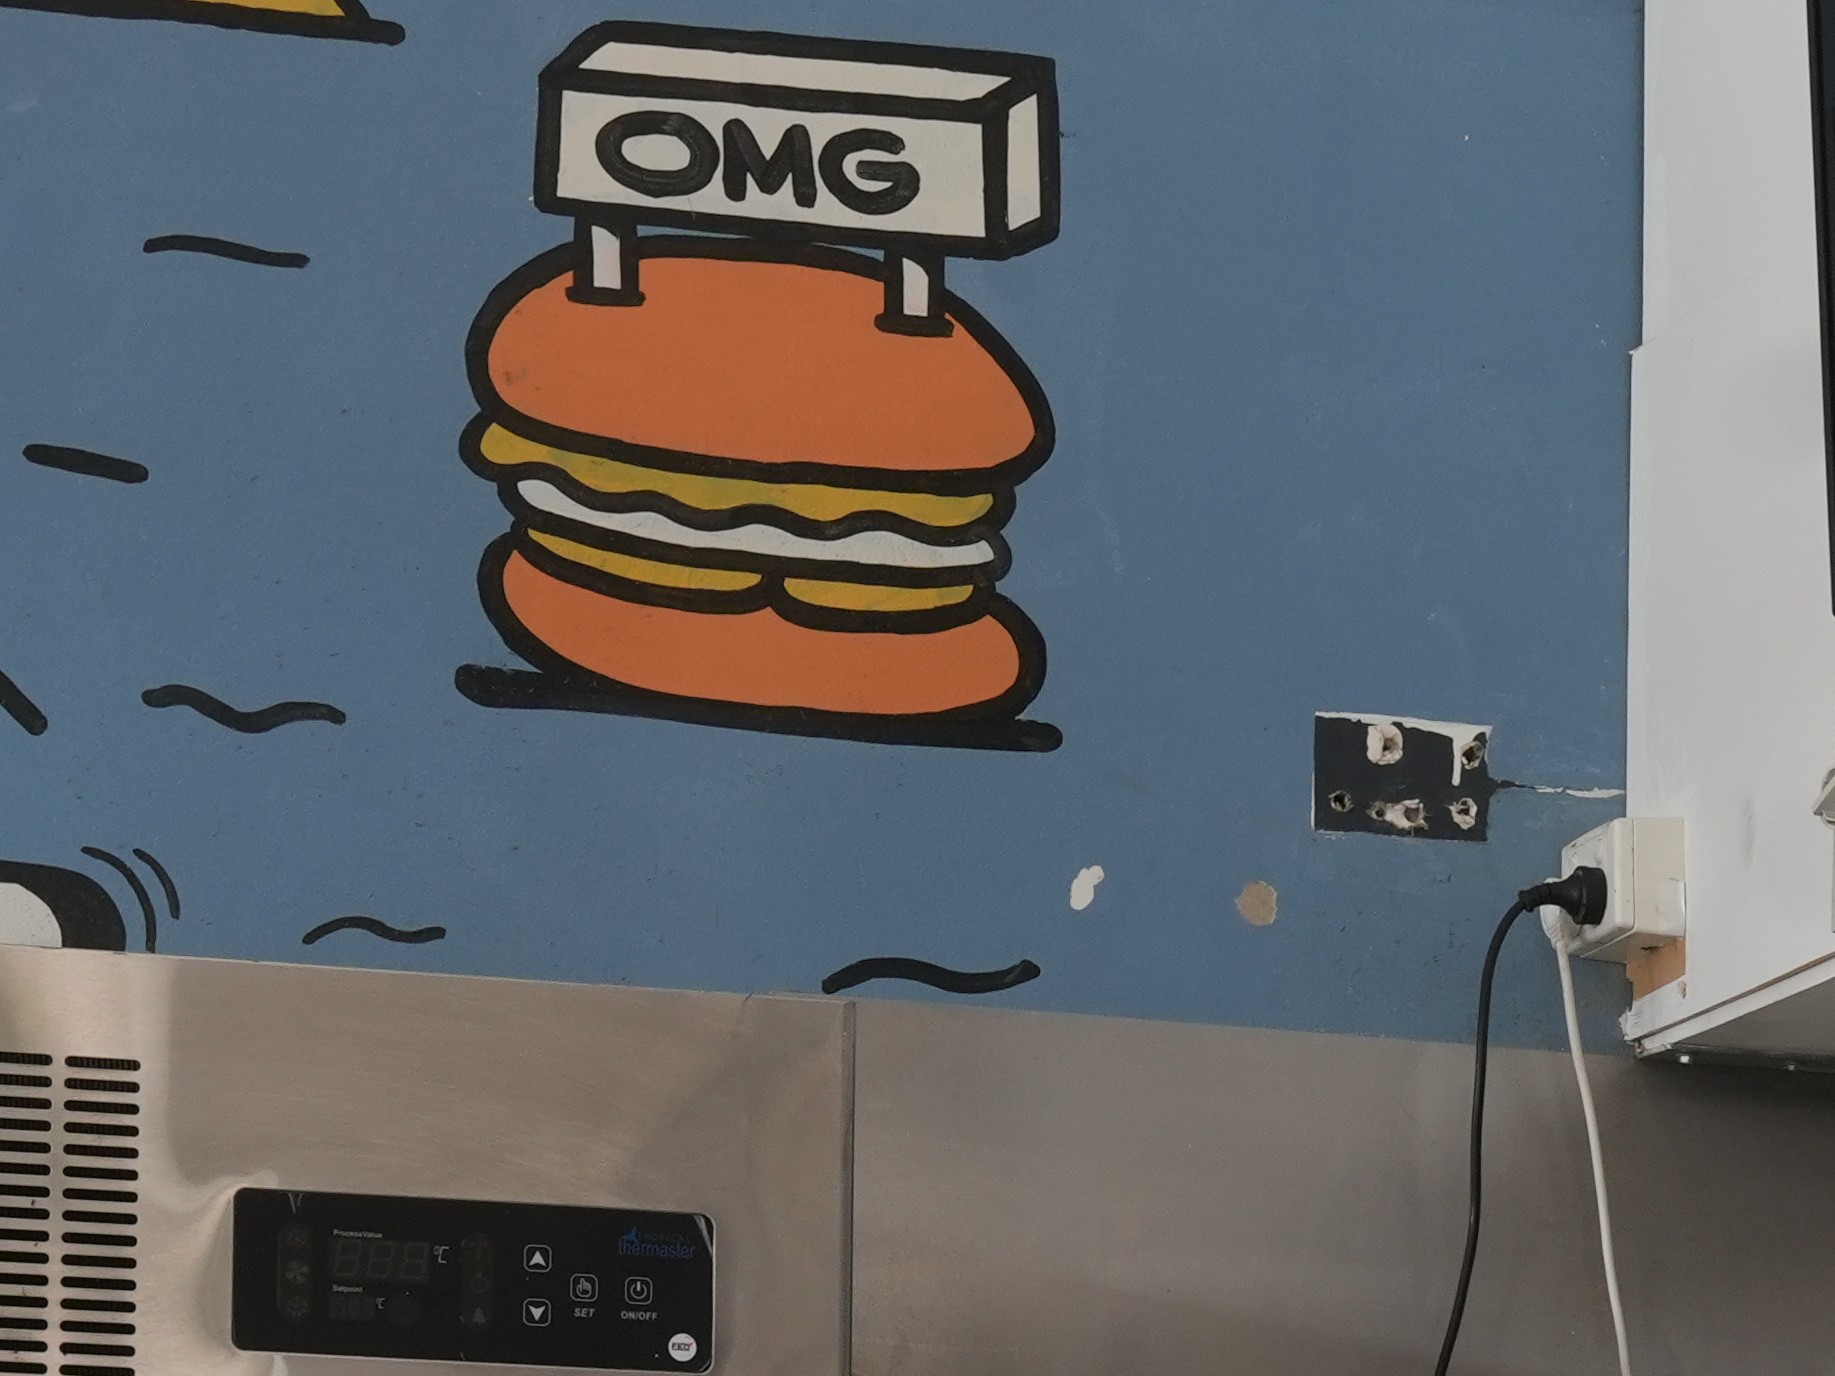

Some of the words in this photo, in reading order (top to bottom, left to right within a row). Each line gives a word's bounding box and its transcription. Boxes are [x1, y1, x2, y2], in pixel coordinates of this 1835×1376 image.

[595, 109, 922, 216] OMG
[574, 1308, 595, 1318] SET
[621, 1310, 658, 1321] ON/OFF
